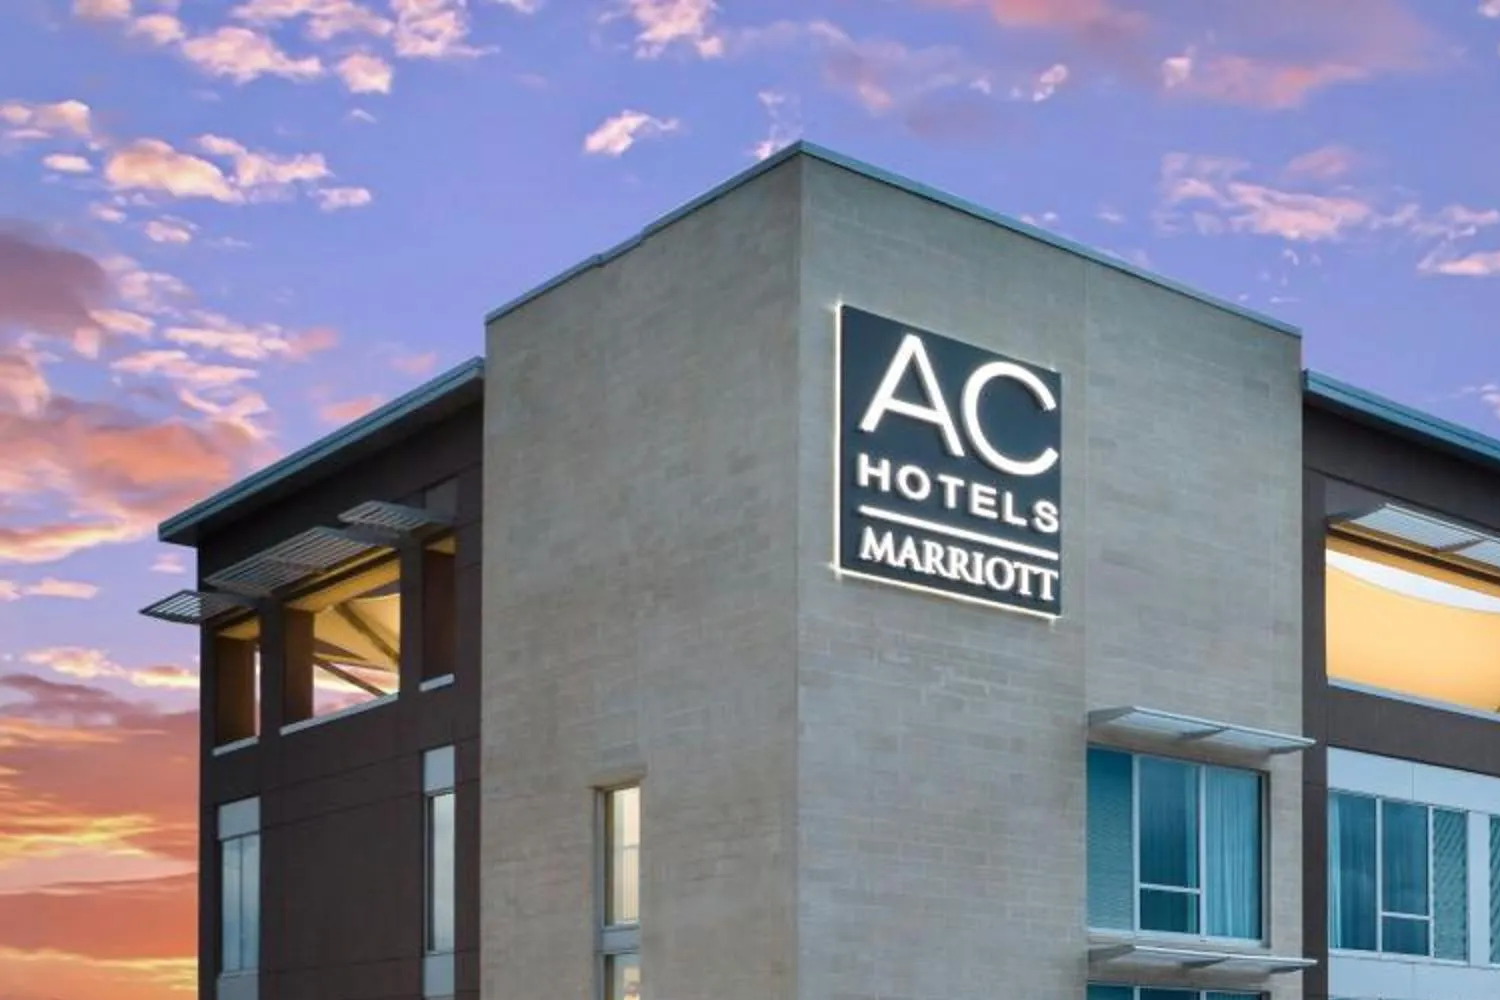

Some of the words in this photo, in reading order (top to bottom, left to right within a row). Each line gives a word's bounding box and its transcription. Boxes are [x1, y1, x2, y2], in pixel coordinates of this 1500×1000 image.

[859, 334, 1059, 476] AC
[858, 453, 1058, 533] HOTELS
[861, 526, 1058, 600] MARRIOTT
